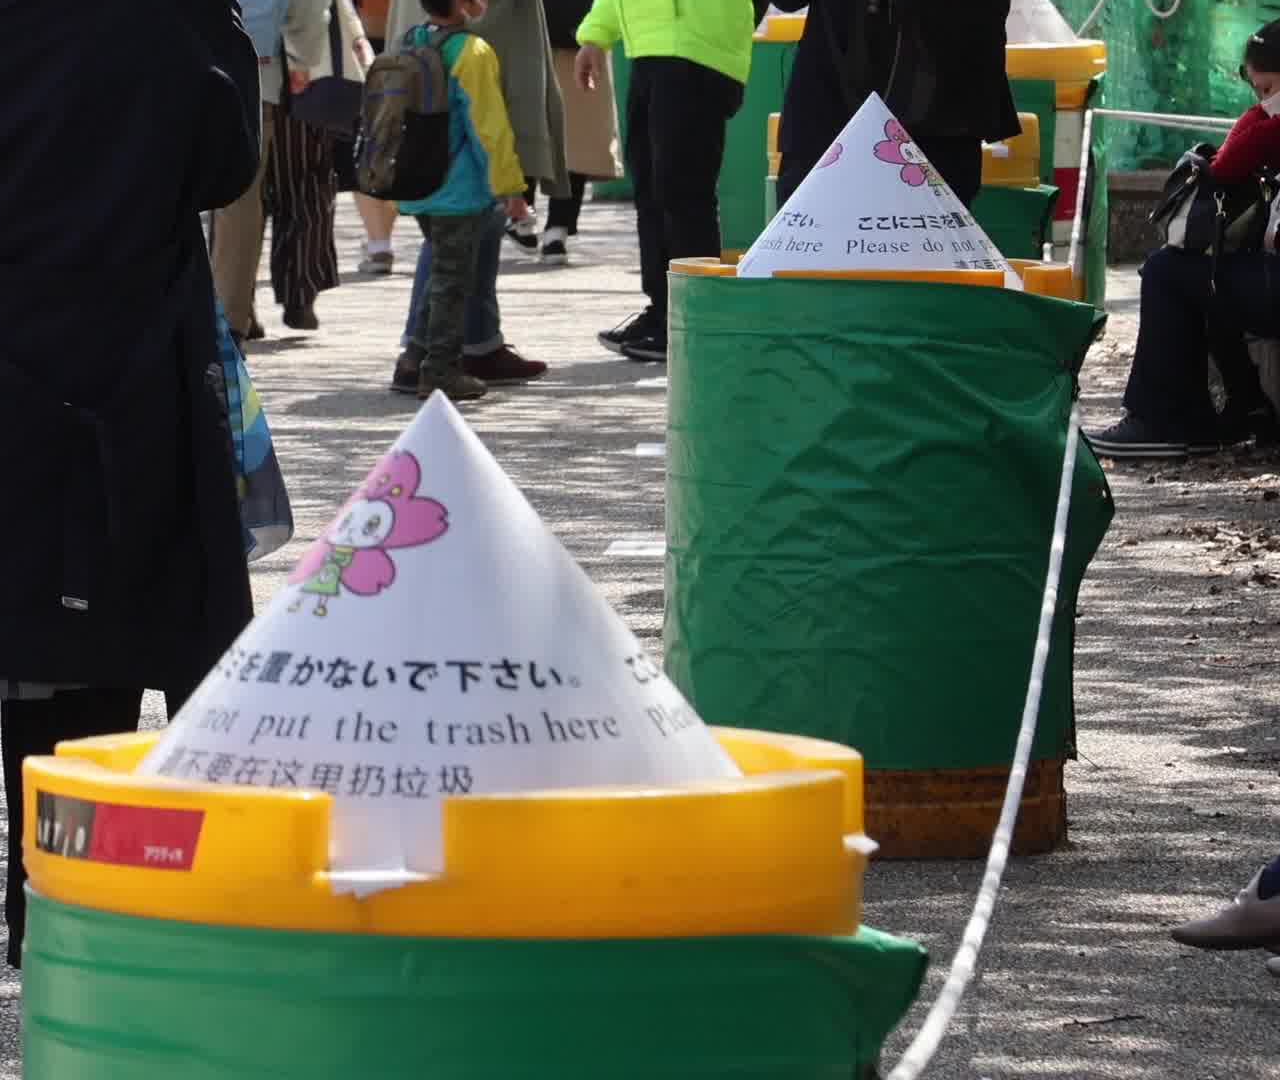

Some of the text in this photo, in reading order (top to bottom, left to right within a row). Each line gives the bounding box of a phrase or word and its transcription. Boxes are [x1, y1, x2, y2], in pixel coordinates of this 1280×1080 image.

[785, 235, 823, 252] here
[847, 239, 910, 254] Please
[922, 238, 944, 253] do
[951, 239, 976, 253] not
[249, 714, 312, 745] put
[335, 711, 398, 744] the
[426, 712, 532, 745] trash
[541, 710, 621, 743] here
